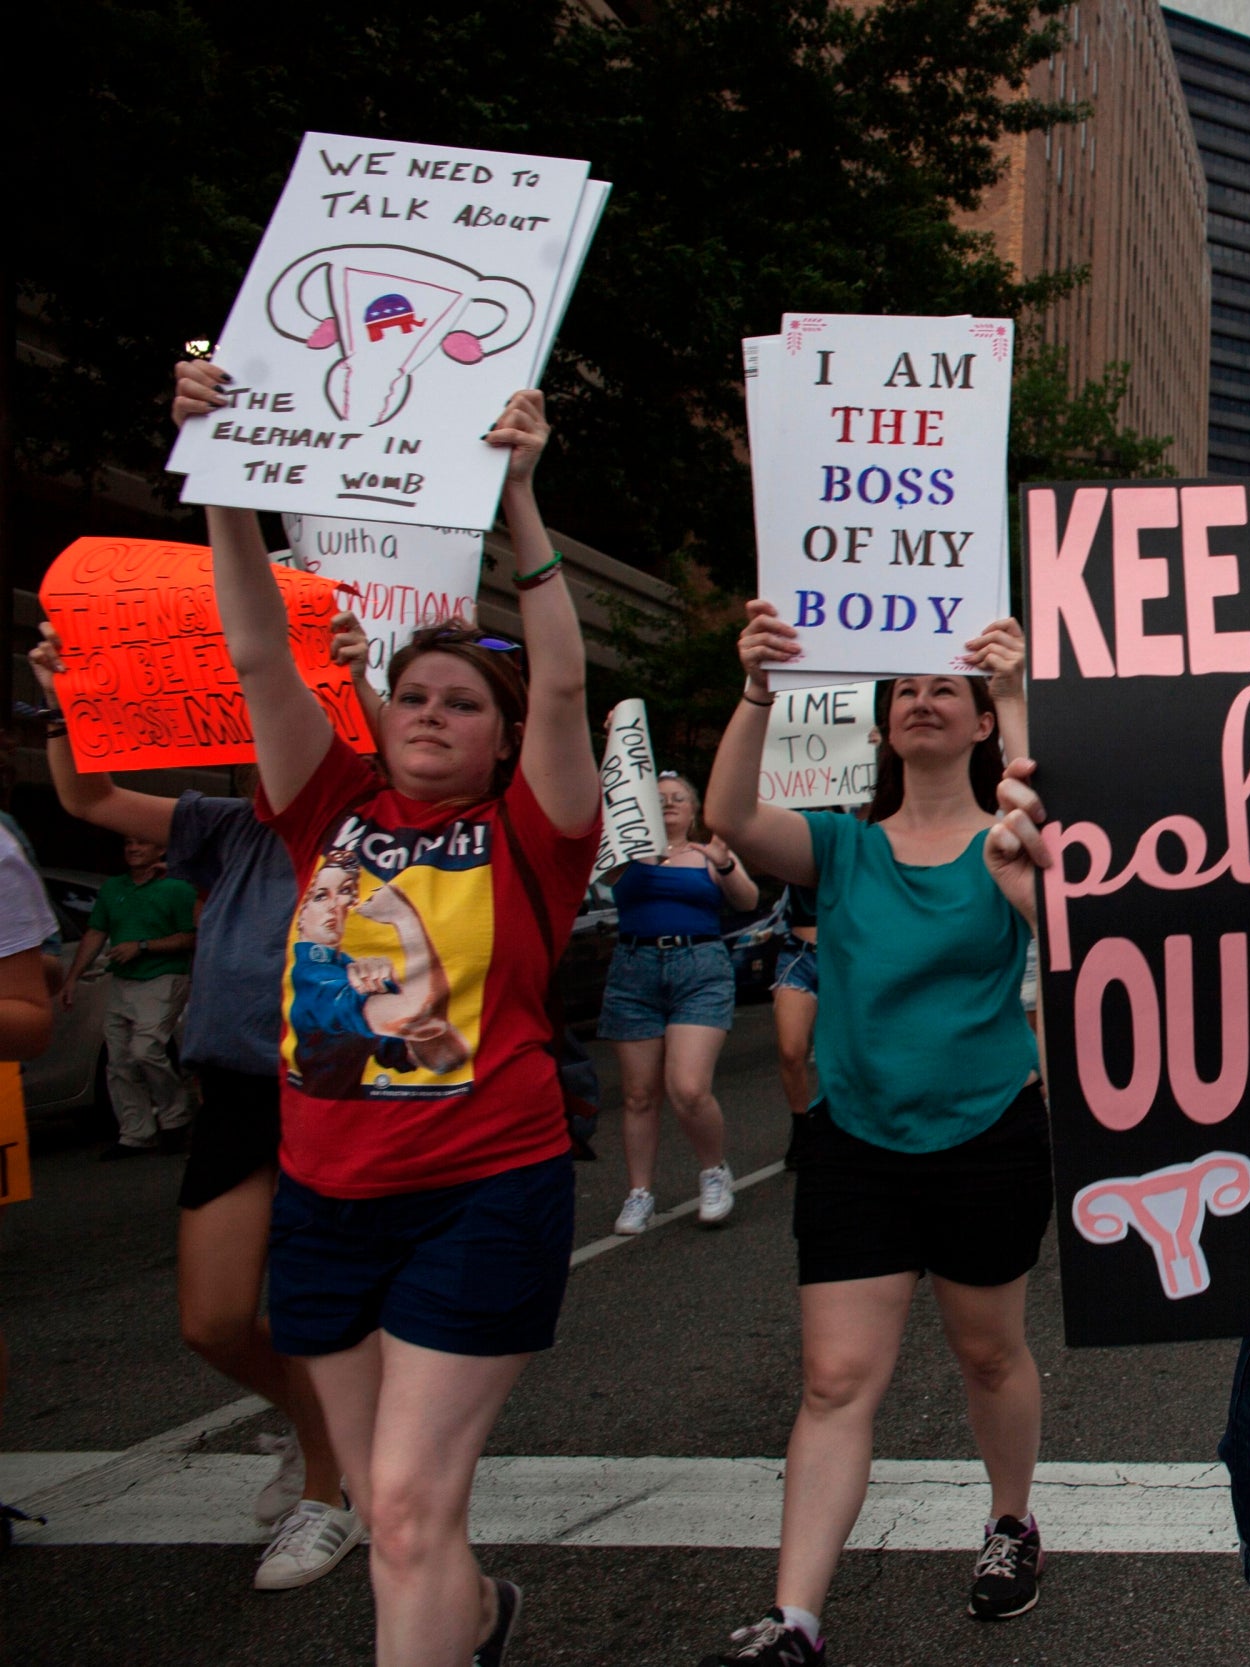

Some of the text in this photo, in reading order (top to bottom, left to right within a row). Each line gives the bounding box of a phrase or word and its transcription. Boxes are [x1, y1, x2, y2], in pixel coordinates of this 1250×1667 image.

[320, 149, 396, 177] WE
[408, 158, 493, 185] NEED
[321, 191, 430, 221] TALK
[814, 349, 977, 390] I AM
[223, 386, 295, 414] THE
[211, 421, 421, 455] ELEPHANT IN
[830, 405, 945, 447] THE
[243, 460, 307, 485] THE
[819, 464, 955, 507] BOSS
[317, 527, 375, 556] with
[382, 534, 398, 559] a
[802, 525, 974, 568] OF MY
[793, 590, 964, 635] BODY
[775, 690, 858, 725] IME
[778, 733, 827, 764] TO
